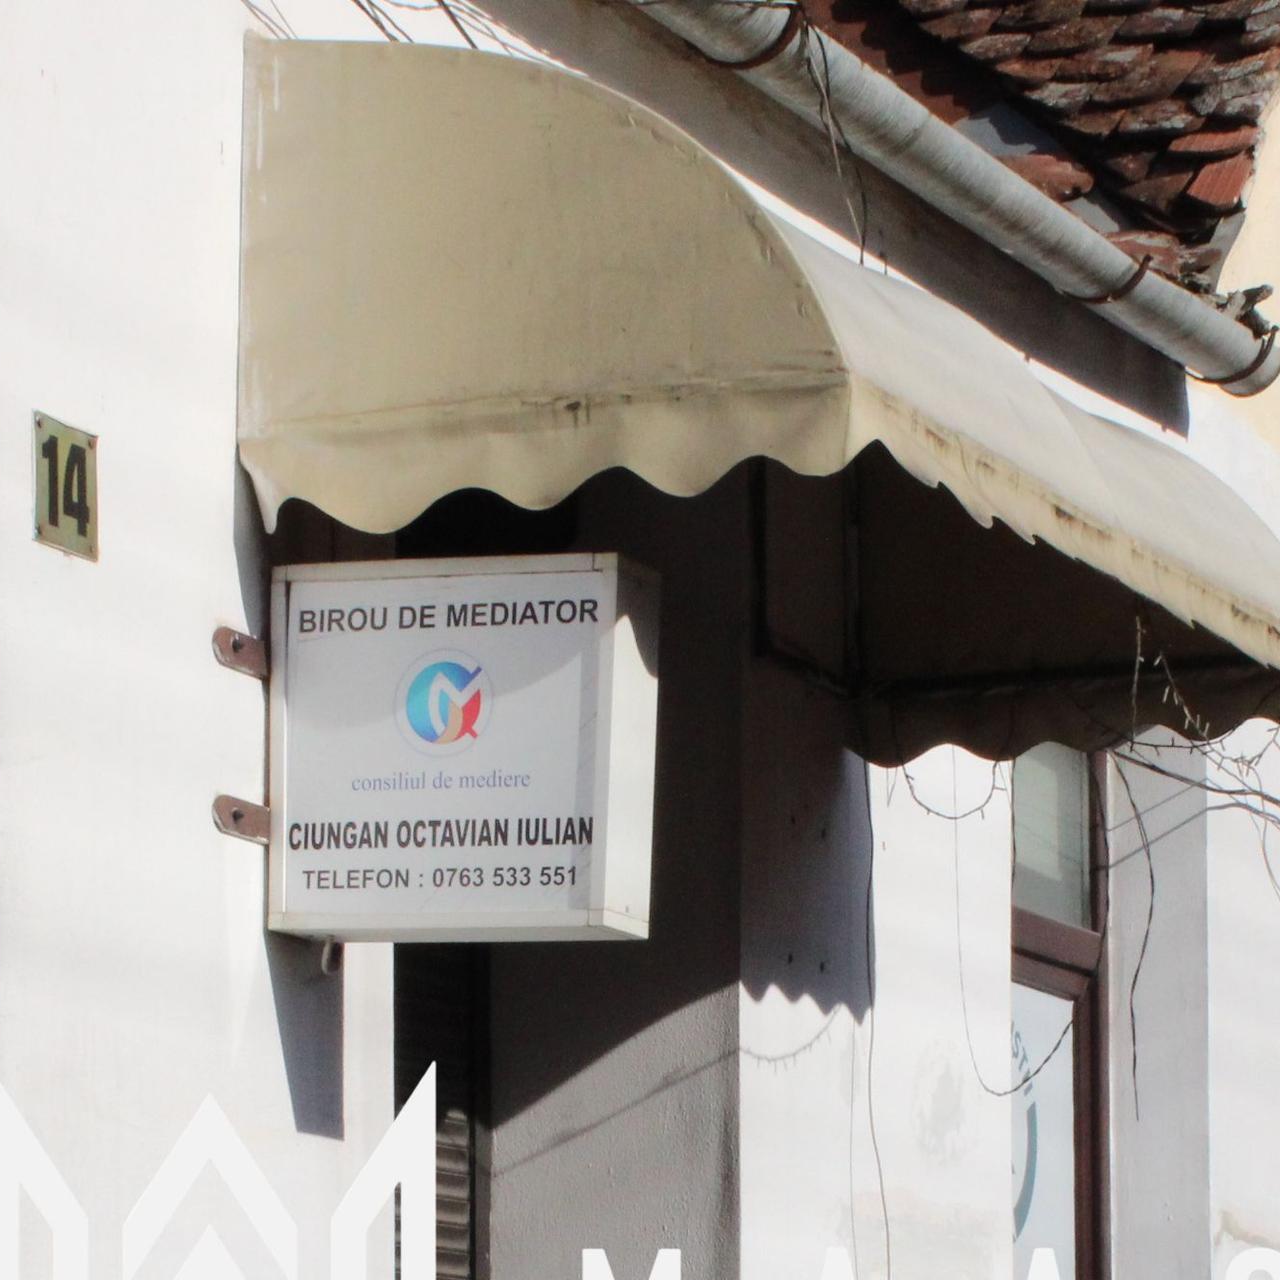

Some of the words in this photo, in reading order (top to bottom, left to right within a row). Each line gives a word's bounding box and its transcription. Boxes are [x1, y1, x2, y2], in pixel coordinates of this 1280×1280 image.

[42, 434, 90, 538] 14
[299, 607, 388, 633] BIROU
[398, 604, 436, 629] DE
[446, 599, 599, 627] MEDIATOR
[351, 772, 426, 792] consiliul
[432, 771, 453, 789] de
[458, 769, 531, 788] mediere
[289, 821, 388, 851] CIUNGAN
[396, 818, 509, 849] OCTAVIAN
[517, 816, 594, 846] IULIAN
[302, 868, 410, 890] TELEFON
[432, 867, 484, 888] 0763
[492, 867, 532, 887] 533
[539, 866, 577, 886] 551
